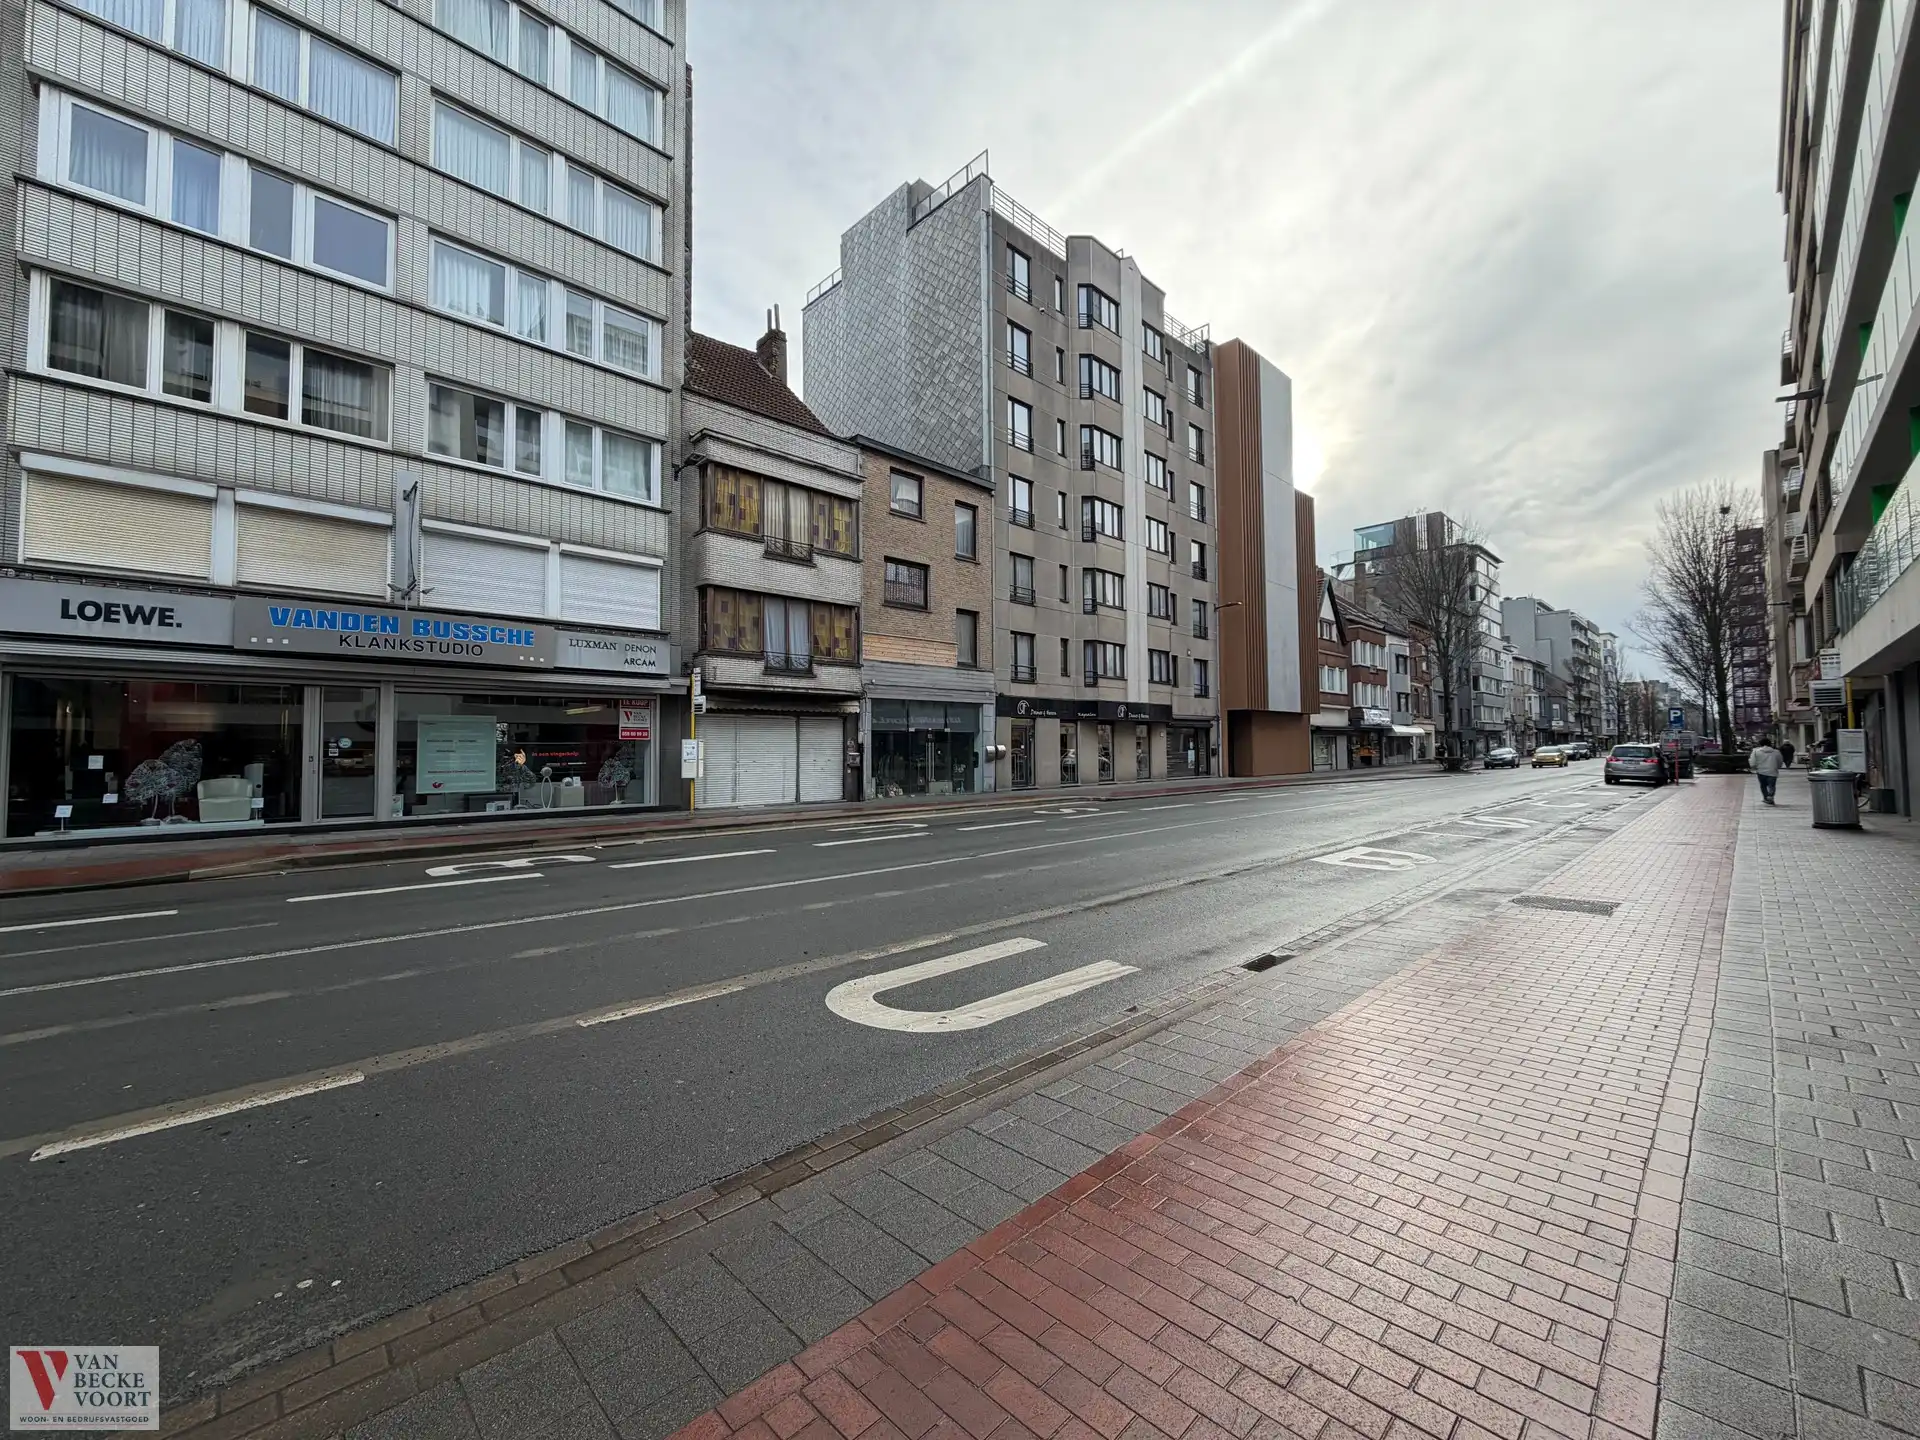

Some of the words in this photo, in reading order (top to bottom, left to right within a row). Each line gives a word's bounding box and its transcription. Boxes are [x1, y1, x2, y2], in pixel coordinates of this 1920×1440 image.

[60, 598, 183, 628] LOEWE.
[267, 605, 400, 635] VANDEN
[412, 618, 535, 647] BUSSCHE
[339, 634, 483, 656] KLANKSTUDIO
[569, 638, 618, 651] LUXMAN
[624, 643, 657, 654] DENON
[623, 657, 656, 667] ARCAM
[1670, 710, 1681, 721] P
